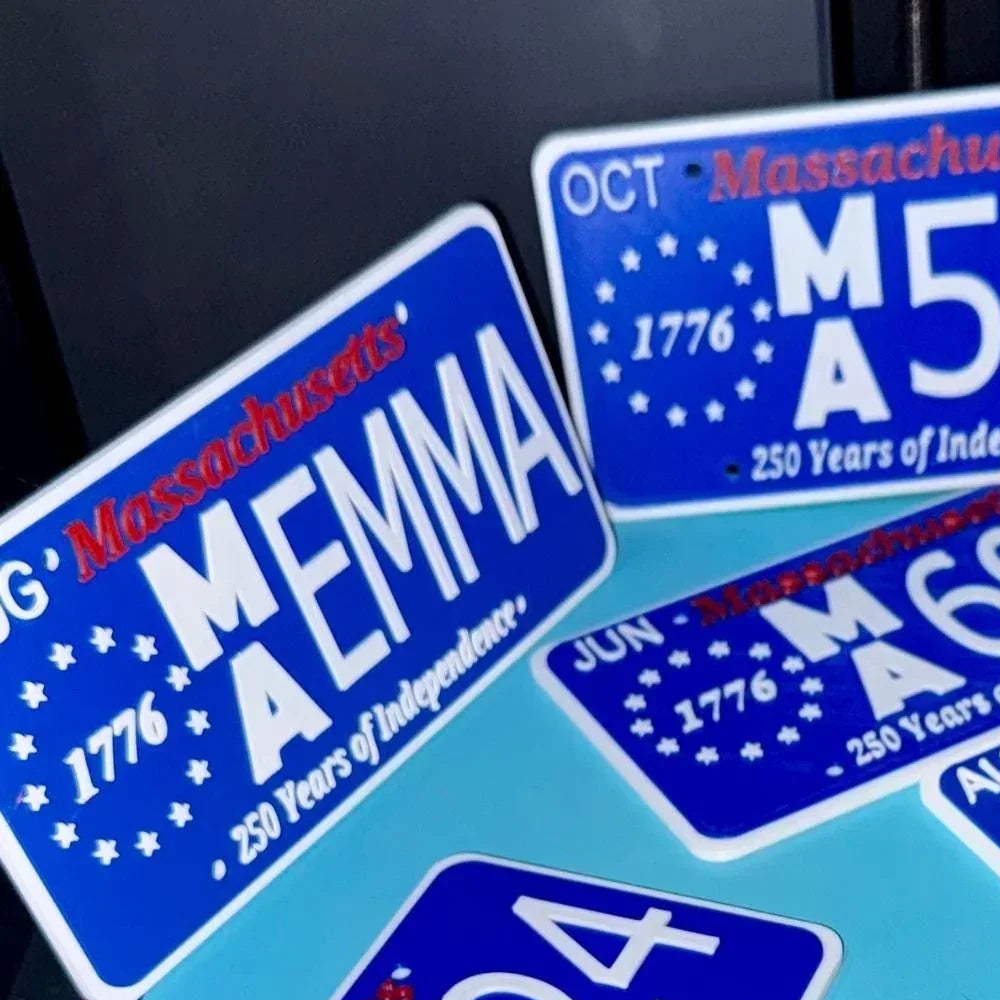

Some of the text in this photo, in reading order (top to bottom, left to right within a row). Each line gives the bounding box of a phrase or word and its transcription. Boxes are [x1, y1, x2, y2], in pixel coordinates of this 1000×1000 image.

[561, 155, 665, 216] OCT
[630, 306, 736, 361] 1776
[64, 313, 407, 583] Massachusetts
[750, 442, 801, 482] 250
[807, 438, 893, 476] Years
[901, 426, 935, 475] of
[249, 323, 583, 690] EMMA
[0, 553, 50, 643] G
[573, 616, 666, 674] JUN
[230, 599, 518, 865] 250 Years of Independence
[673, 672, 778, 735] 1776
[846, 725, 902, 767] 250
[898, 692, 992, 743] Years
[62, 692, 169, 804] 1776
